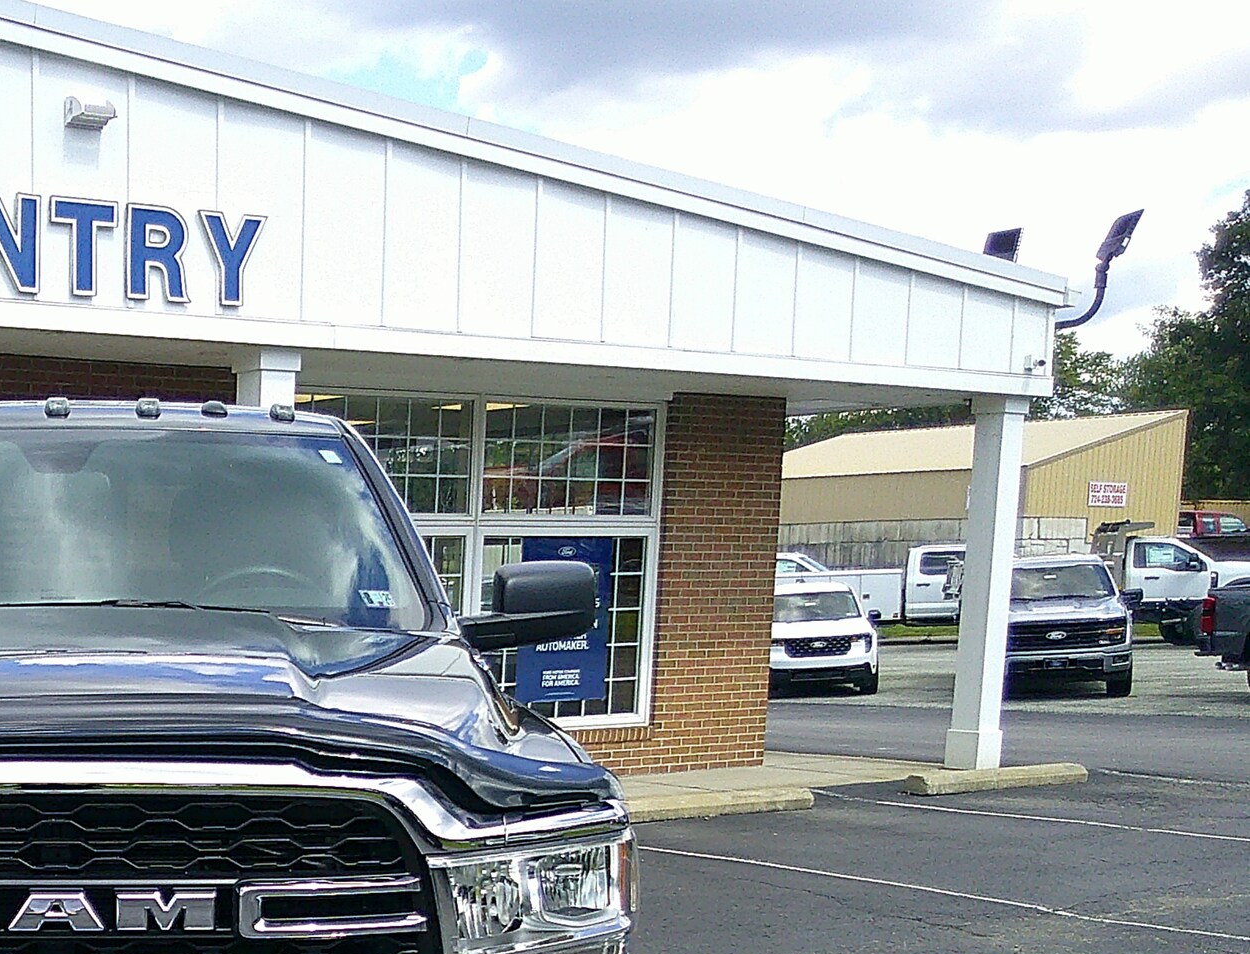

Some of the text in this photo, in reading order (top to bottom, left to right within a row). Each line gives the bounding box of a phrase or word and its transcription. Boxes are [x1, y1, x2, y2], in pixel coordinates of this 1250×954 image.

[1090, 484, 1126, 494] SELF STORAGE
[535, 640, 590, 652] AUTOMAKER.
[541, 680, 554, 688] FOR
